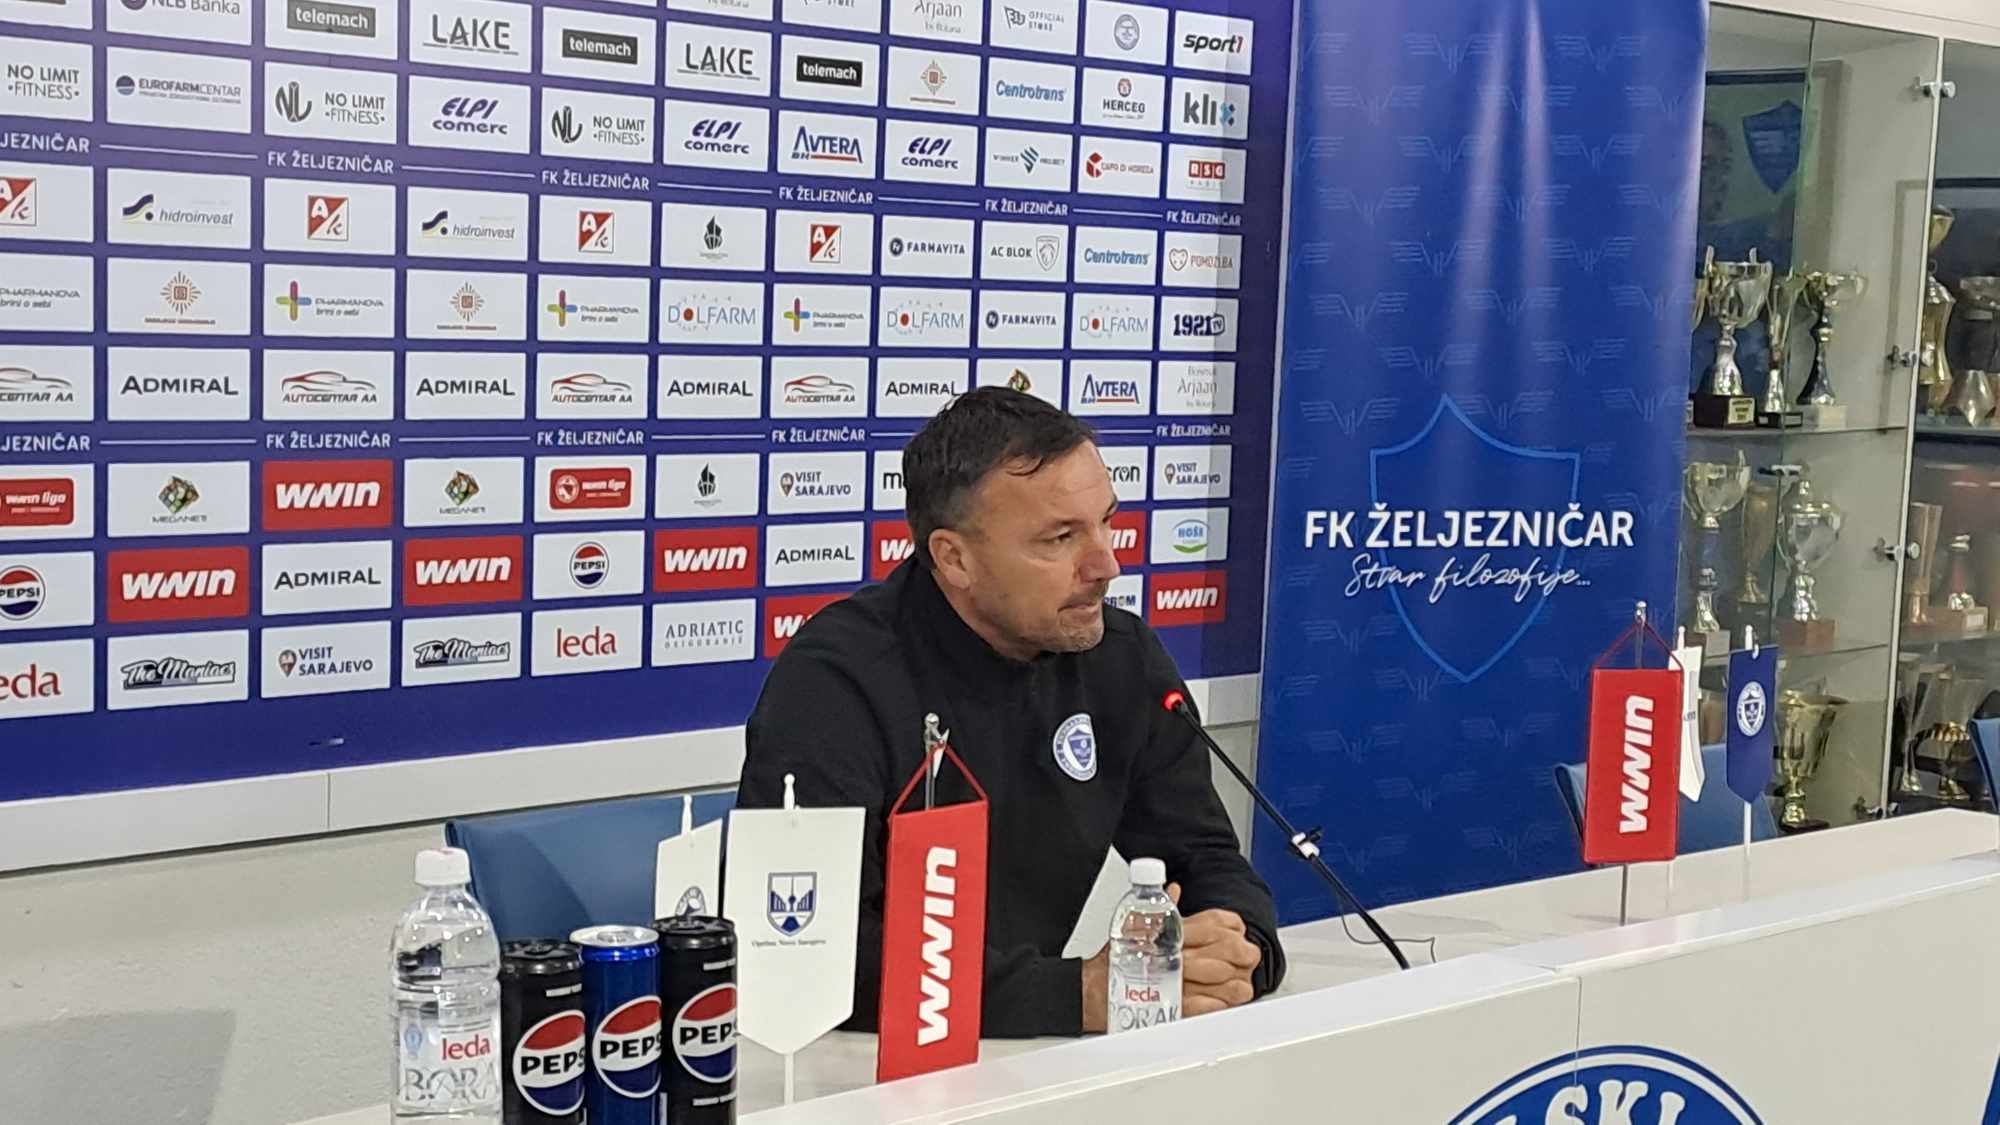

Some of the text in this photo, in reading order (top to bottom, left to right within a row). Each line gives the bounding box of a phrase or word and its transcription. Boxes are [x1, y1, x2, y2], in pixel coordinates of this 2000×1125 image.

[191, 0, 241, 15] Banka
[295, 9, 369, 30] telemach
[1029, 11, 1065, 24] OFFICIAL
[432, 14, 511, 50] LAKE
[569, 34, 633, 57] telemach
[1183, 34, 1242, 53] sport1
[685, 42, 754, 75] LAKE
[7, 64, 80, 84] NO LIMIT
[802, 62, 857, 81] telemach
[996, 80, 1064, 102] Centrotrans
[325, 93, 386, 111] NO LIMIT
[441, 97, 498, 120] ELPI
[432, 118, 508, 136] comerc
[593, 115, 645, 133] NO LIMIT
[691, 118, 742, 140] ELPI
[683, 139, 750, 155] comerc
[908, 137, 953, 156] ELPI
[267, 149, 394, 175] FK ŽELJEZNIČAR
[901, 156, 959, 170] comerc
[542, 168, 650, 191] FK ŽELJEZNIČAR
[779, 185, 874, 204] FK ŽELJEZNIČAR
[985, 198, 1068, 216] FK ŽELJEZNIČAR
[159, 208, 234, 226] hidroinvest
[1167, 209, 1242, 227] FK ŽELJEZNIČAR
[453, 221, 516, 240] hidroinvest
[907, 241, 966, 255] FARMAVITA
[991, 246, 1032, 258] AC BLOK
[1084, 248, 1149, 266] Centrotrans
[1002, 313, 1057, 327] FARMAVITA
[121, 375, 239, 397] ADMIRAL
[416, 377, 516, 397] ADMIRAL
[667, 379, 754, 398] ADMIRAL
[885, 380, 964, 397] ADMIRAL
[55, 392, 74, 402] AA
[282, 393, 377, 404] AUTOCENTAR AA
[619, 394, 633, 404] AA
[266, 430, 392, 449] FK ŽELJEZNIČAR
[537, 428, 645, 447] FK ŽELJEZNIČAR
[772, 426, 866, 443] FK ŽELJEZNIČAR
[1157, 423, 1231, 438] FK ŽELJEZNIČAR
[1176, 462, 1198, 473] VISIT
[795, 471, 822, 483] VISIT
[1176, 473, 1221, 485] SARAJEVO
[795, 484, 851, 497] SARAJEVO
[1304, 502, 1635, 549] FK ŽELJEZNIČAR
[775, 545, 856, 566] ADMIRAL
[573, 560, 606, 571] PEPSI
[274, 567, 382, 590] ADMIRAL
[665, 619, 744, 639] ADRIATIC
[556, 625, 617, 659] leda
[299, 646, 334, 661] VISIT
[299, 659, 374, 676] SARAJEVO
[1125, 984, 1161, 1003] leda
[441, 1034, 491, 1062] leda
